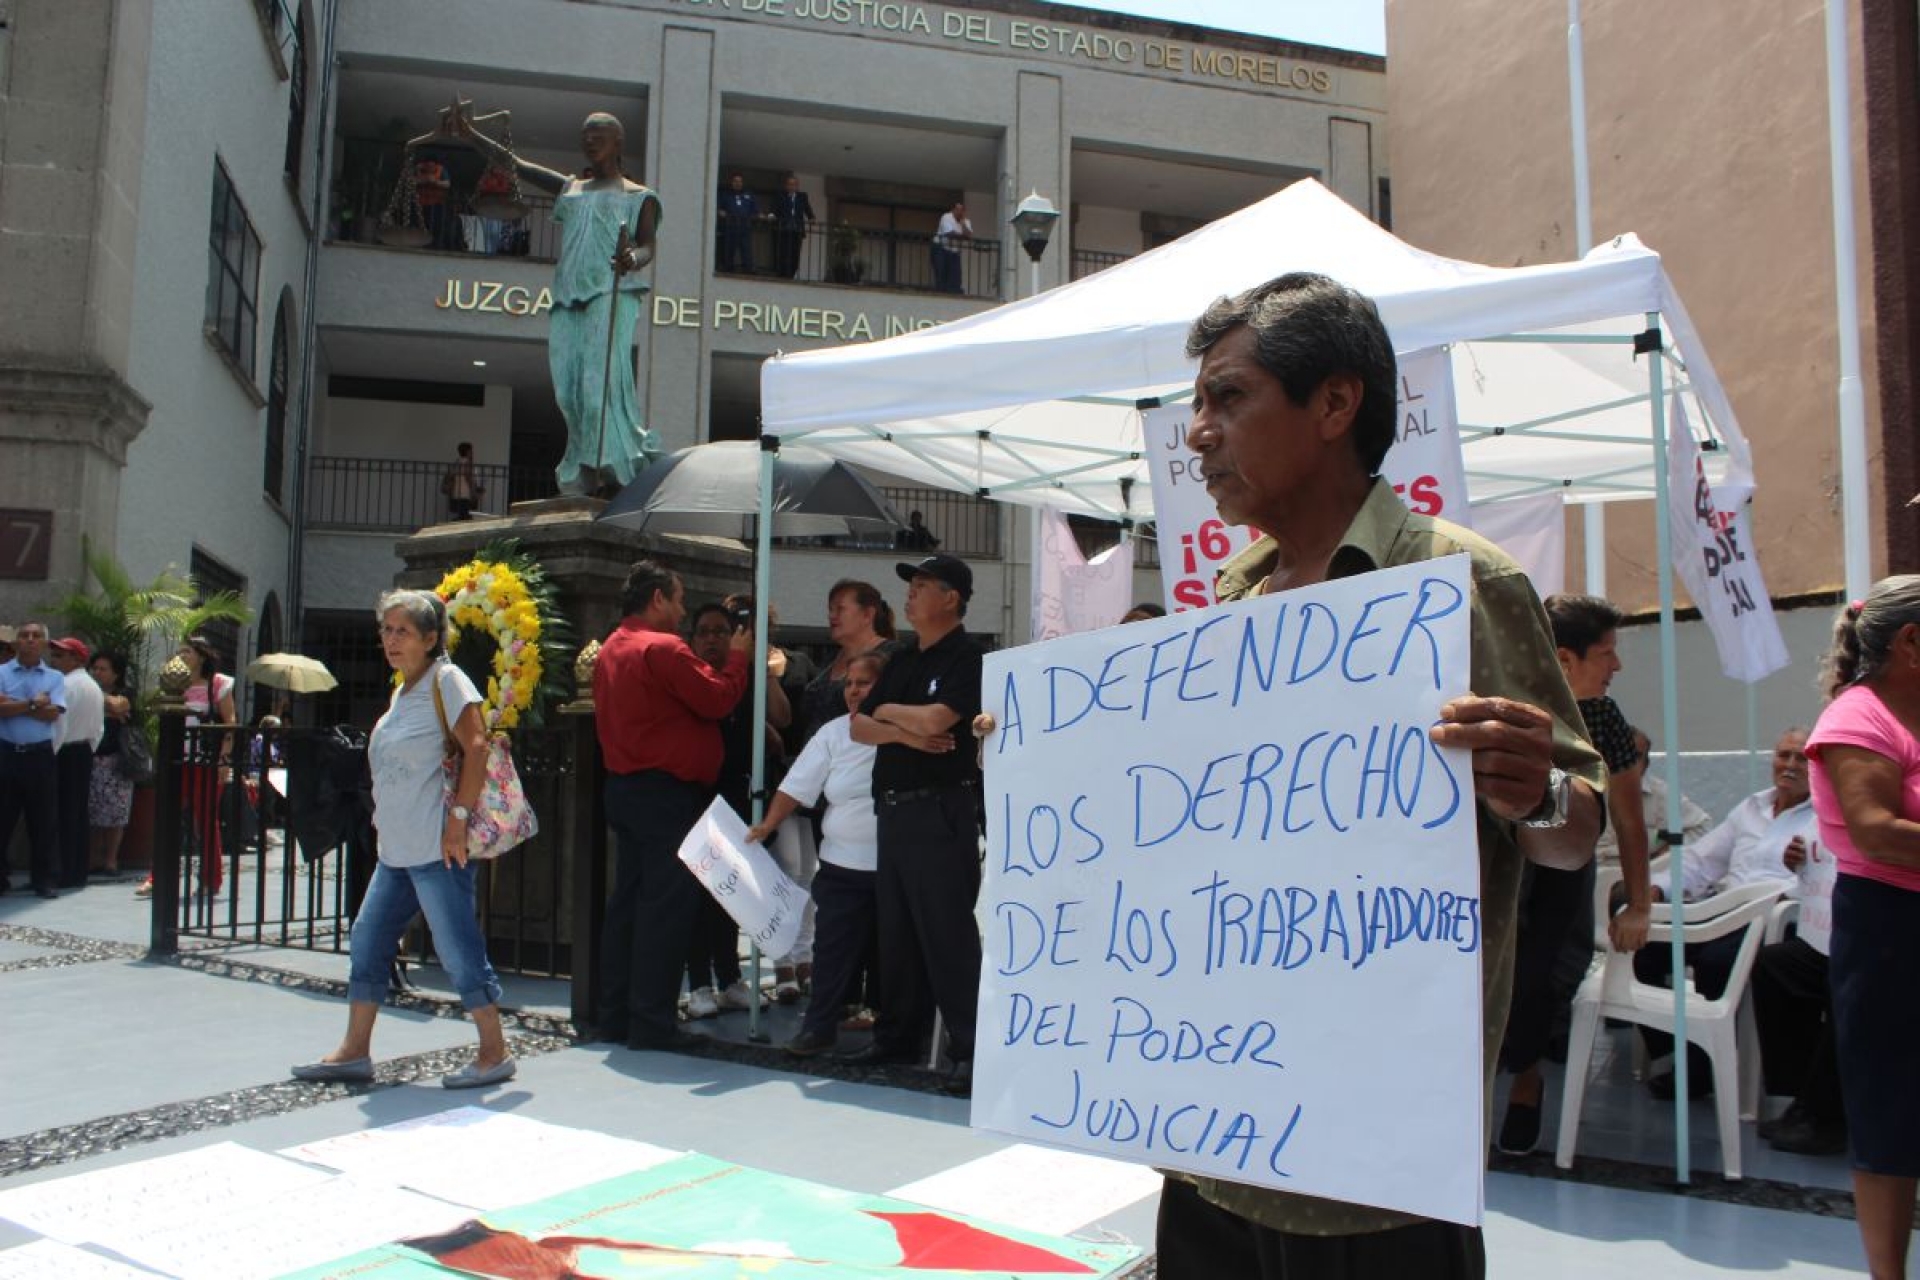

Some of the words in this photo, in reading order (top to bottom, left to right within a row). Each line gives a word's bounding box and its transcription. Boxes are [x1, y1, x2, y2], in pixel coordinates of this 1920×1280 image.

[795, 0, 932, 34] JUSTICIA
[942, 11, 1001, 45] DEL
[1009, 21, 1136, 63] ESTADO
[1144, 43, 1183, 71] DE
[1192, 49, 1332, 93] MORELOS
[435, 279, 554, 316] JUZGA
[652, 296, 701, 328] DE
[714, 299, 873, 341] PRIMERA
[998, 671, 1023, 755] A
[1042, 577, 1463, 734] DEFENDER
[1003, 792, 1105, 877] LOS
[1125, 718, 1461, 848] DERECHOS
[996, 901, 1084, 976] DE
[1105, 879, 1178, 977] LOS
[1192, 870, 1480, 976] TRABAJADORES
[1004, 993, 1088, 1047] DEL
[1106, 996, 1284, 1069] PODER
[1031, 1069, 1302, 1177] JUDICIAL
